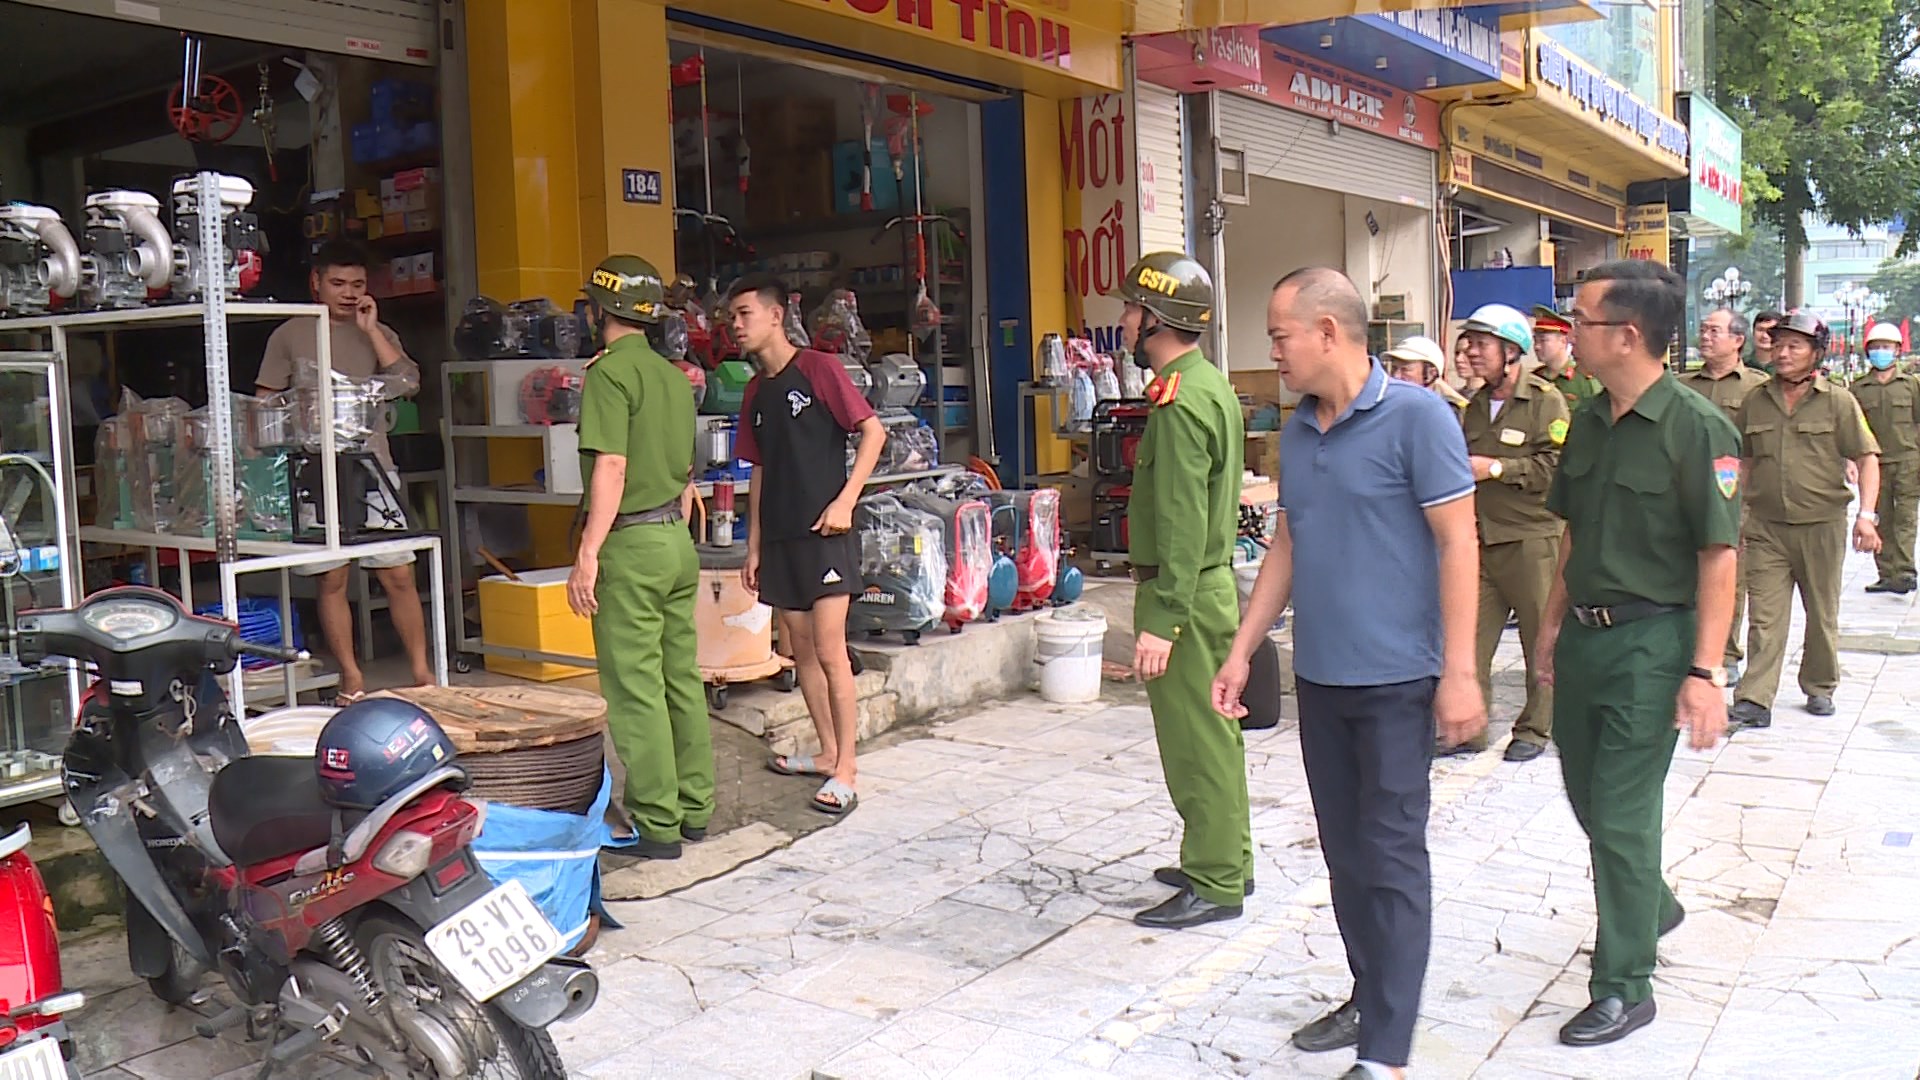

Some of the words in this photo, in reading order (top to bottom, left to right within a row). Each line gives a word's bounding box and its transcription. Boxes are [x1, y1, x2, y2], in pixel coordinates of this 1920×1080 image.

[1289, 71, 1384, 120] ADLER
[627, 173, 658, 195] 184
[1138, 266, 1181, 297] CSTT
[446, 893, 524, 957] 29-V1
[472, 924, 547, 984] 1096
